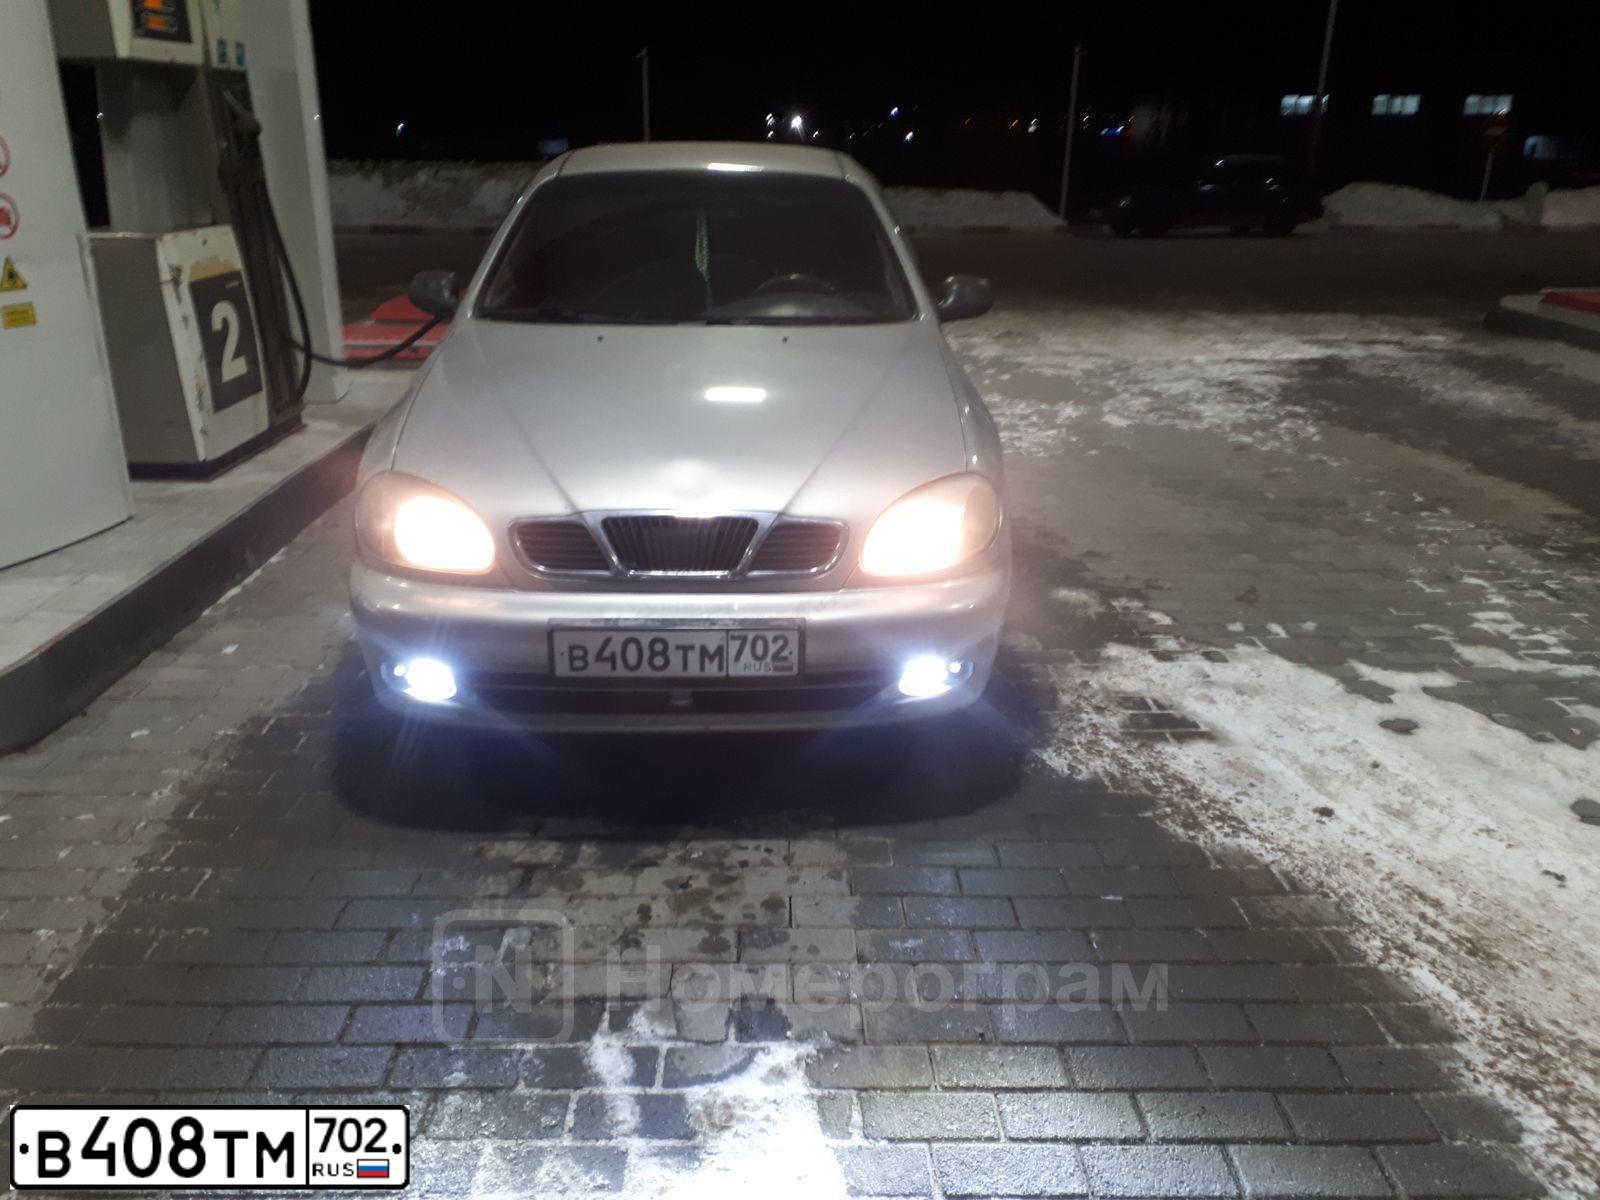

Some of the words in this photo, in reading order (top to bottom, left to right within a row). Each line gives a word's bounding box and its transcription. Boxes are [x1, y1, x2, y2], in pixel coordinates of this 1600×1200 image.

[211, 300, 248, 384] 2
[729, 634, 790, 663] 702
[743, 663, 772, 673] RUS
